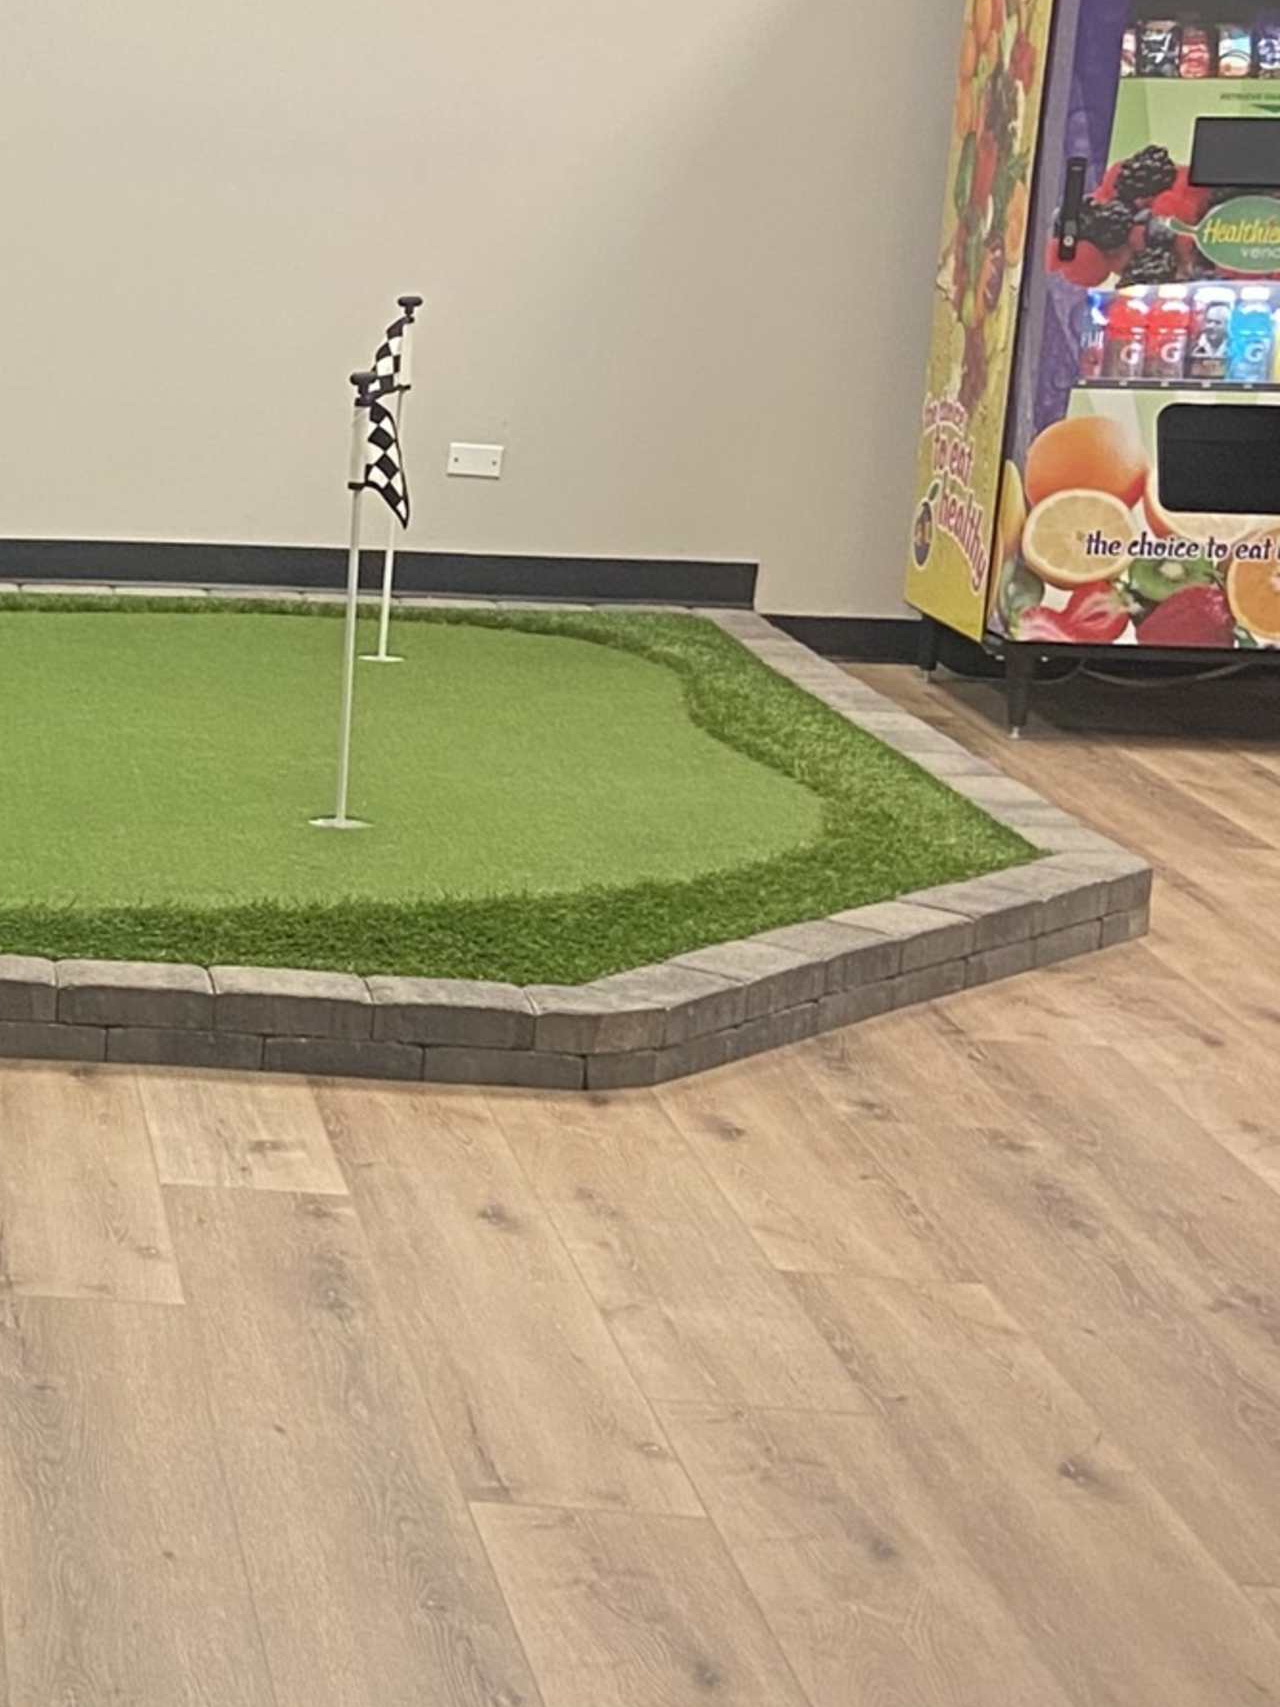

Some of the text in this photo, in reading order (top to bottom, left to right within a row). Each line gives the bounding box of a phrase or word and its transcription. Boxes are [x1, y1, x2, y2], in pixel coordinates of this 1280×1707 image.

[1160, 344, 1180, 363] G
[1245, 344, 1265, 363] G
[1085, 529, 1122, 557] the
[1127, 531, 1199, 559] choice
[1207, 536, 1228, 559] to
[1235, 538, 1272, 561] eat
